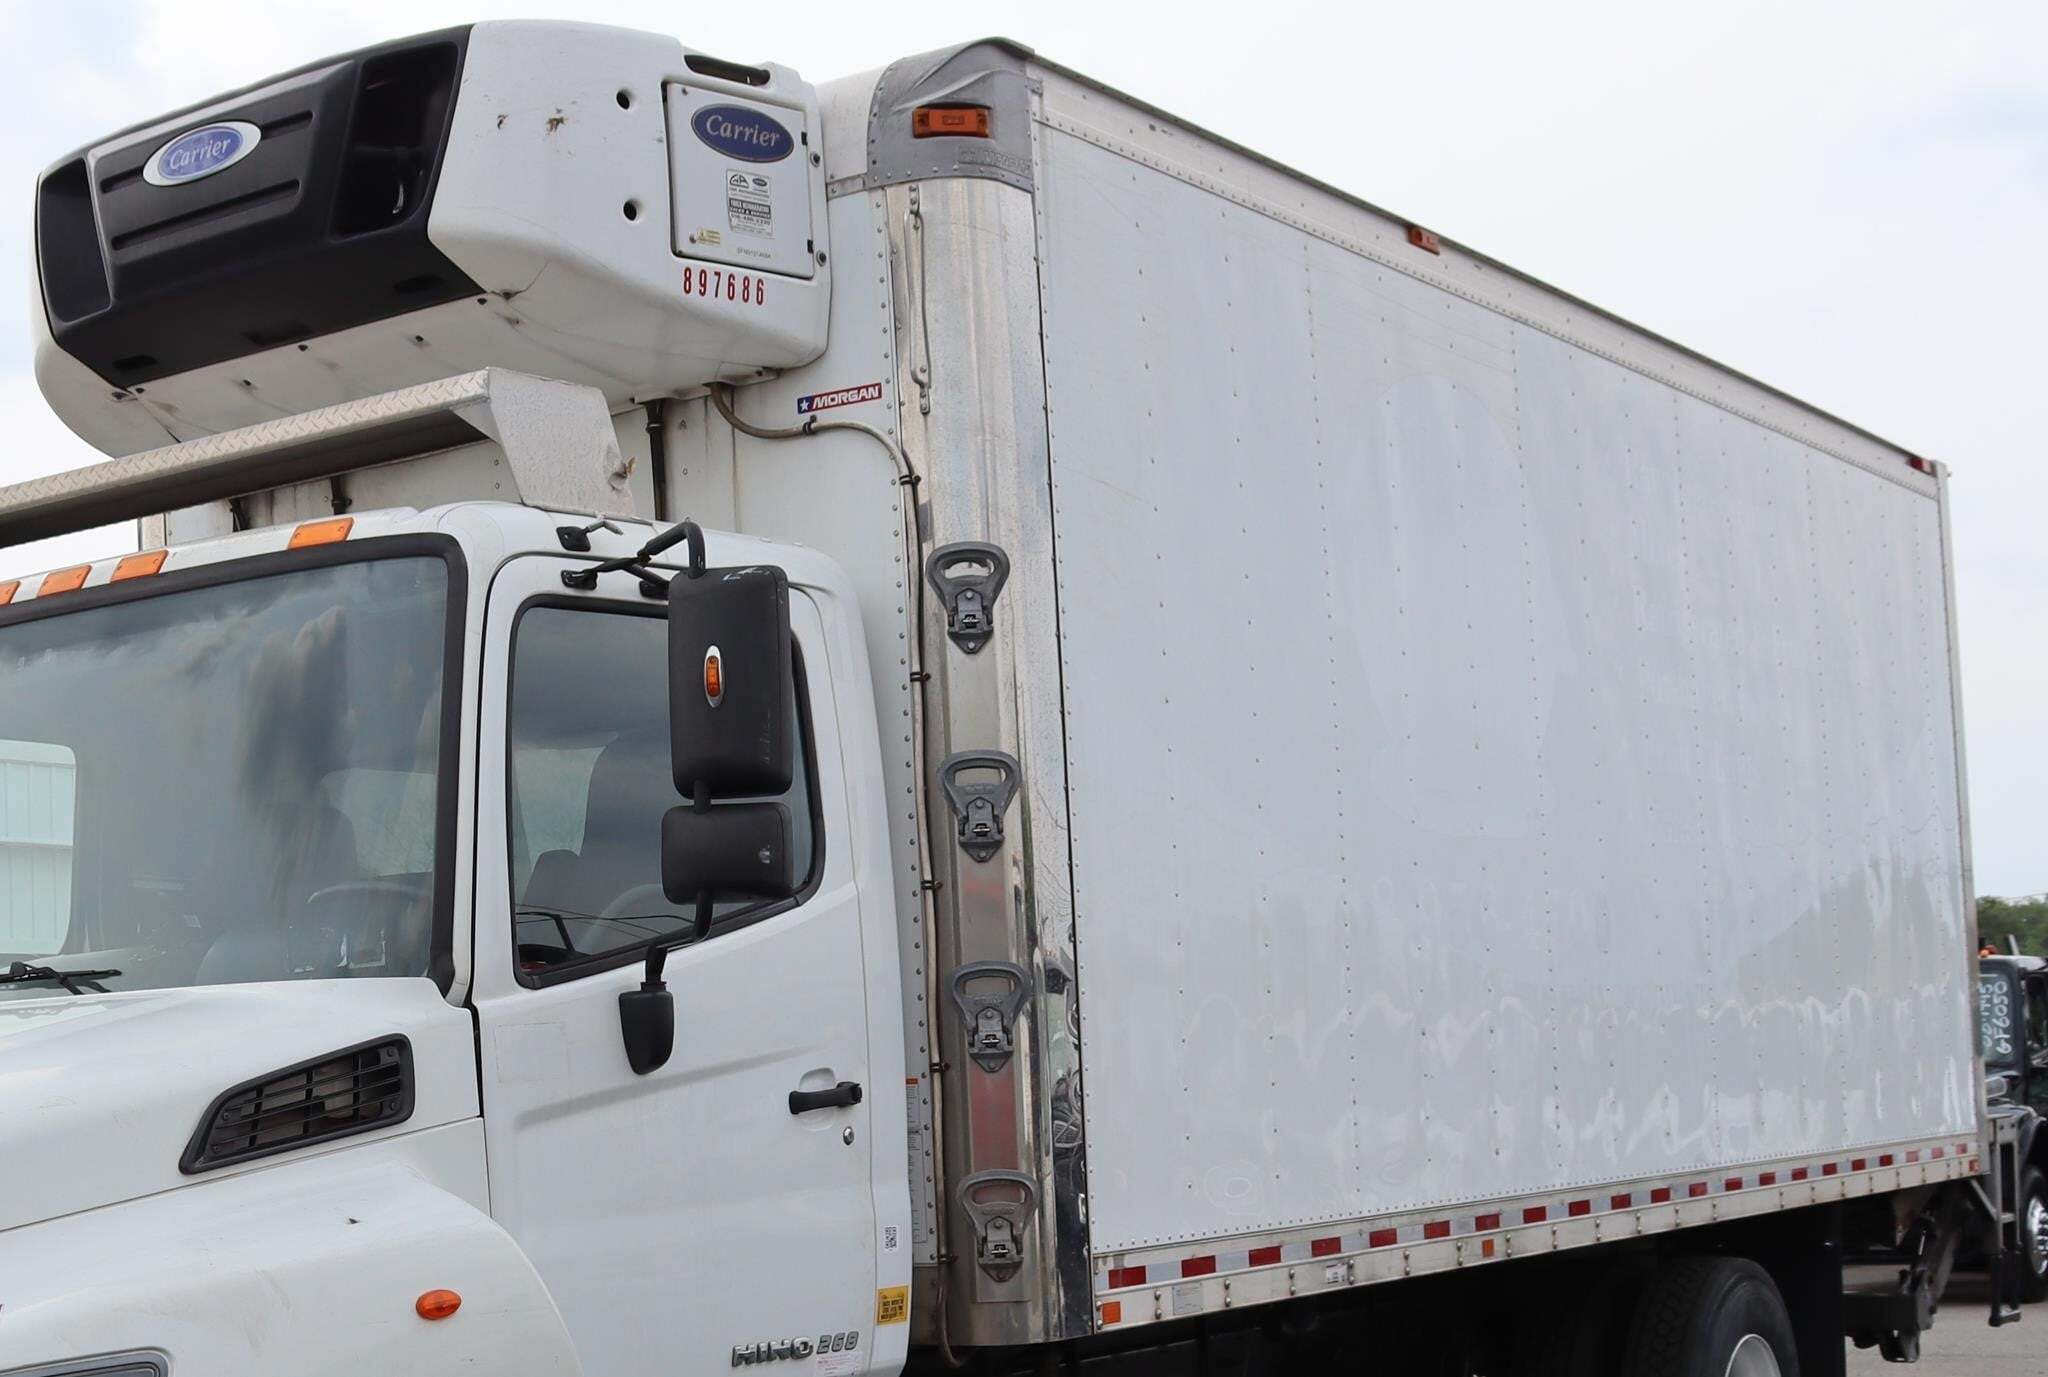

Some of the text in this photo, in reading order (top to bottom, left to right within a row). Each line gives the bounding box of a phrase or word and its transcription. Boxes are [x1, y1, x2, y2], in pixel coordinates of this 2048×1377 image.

[706, 114, 780, 148] Carrier
[168, 138, 232, 170] Carrier
[683, 266, 765, 306] 897686
[811, 385, 879, 410] MORGAN
[731, 1336, 815, 1368] HINO
[816, 1331, 860, 1355] 268
